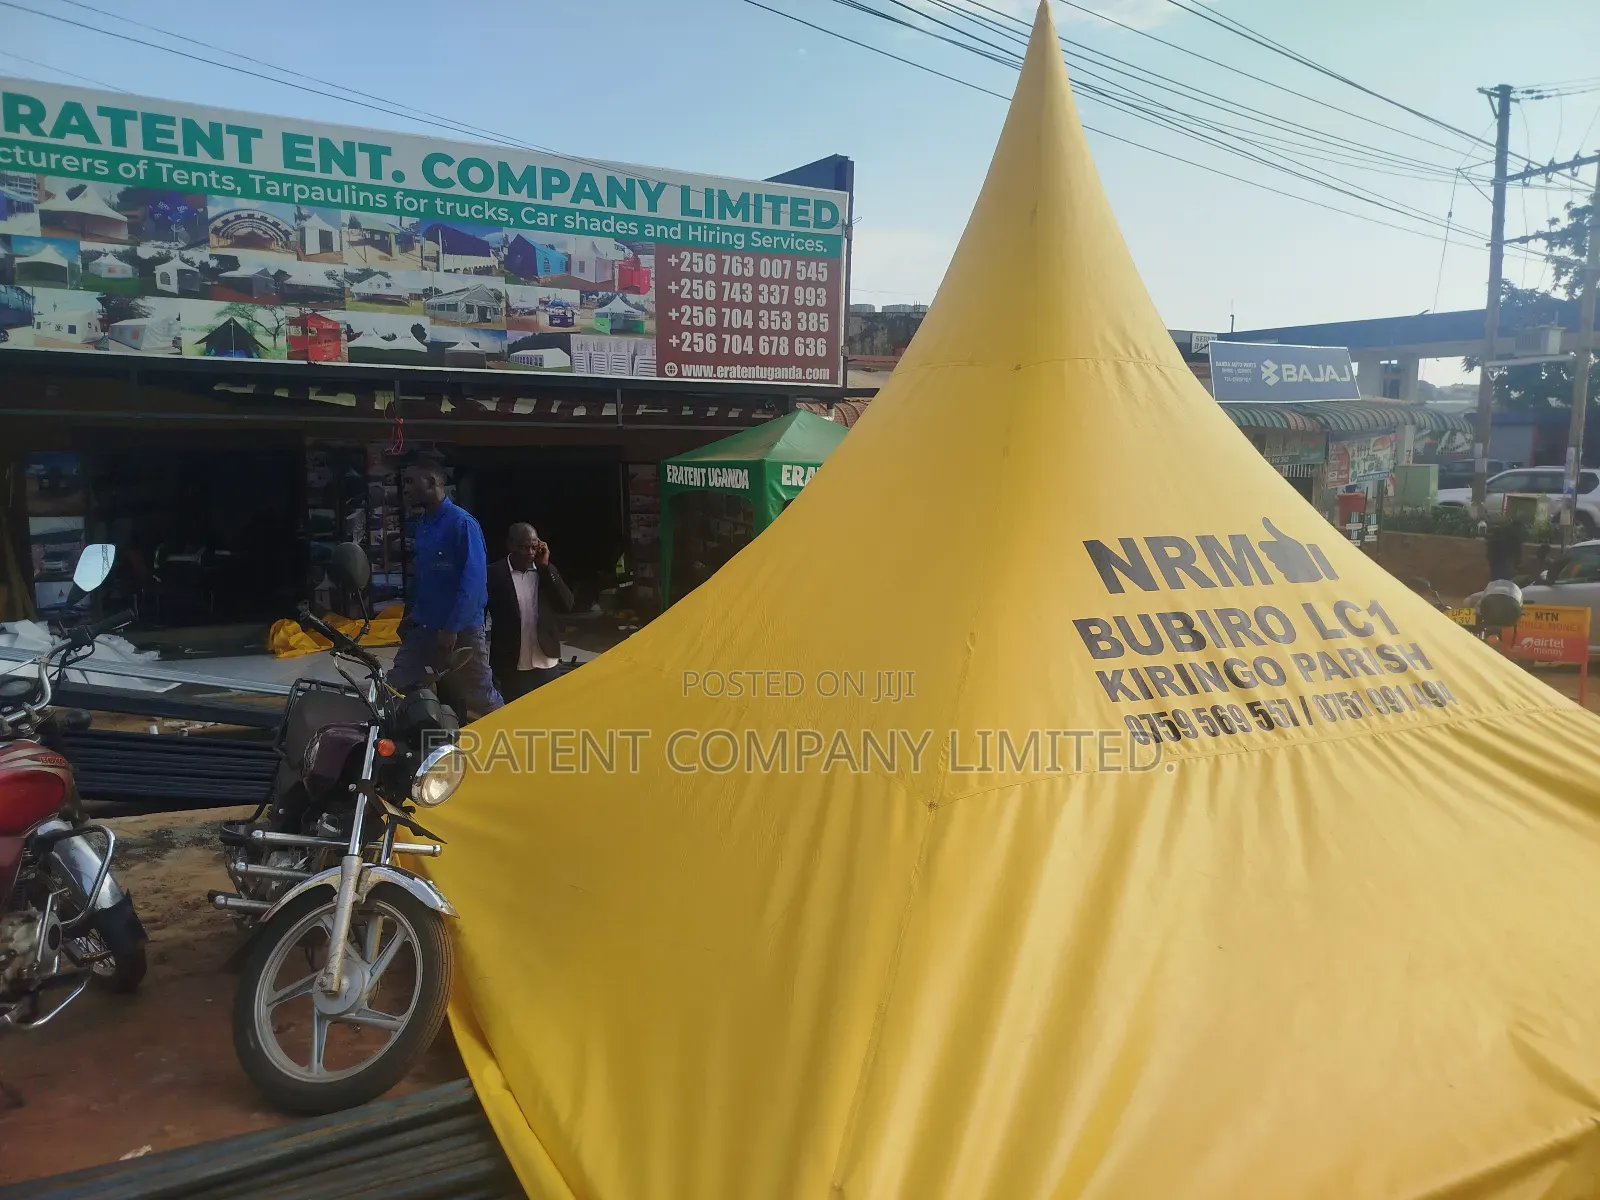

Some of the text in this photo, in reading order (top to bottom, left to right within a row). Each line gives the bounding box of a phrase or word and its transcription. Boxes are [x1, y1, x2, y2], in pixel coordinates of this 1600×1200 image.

[2, 92, 840, 230] RATENT ENT. COMPANY LIMITED
[118, 158, 148, 181] of
[155, 162, 242, 195] Tents,
[250, 173, 389, 210] Tarpaulins
[393, 190, 429, 216] for
[435, 196, 514, 226] trucks,
[521, 207, 558, 227] Car
[564, 211, 639, 236] shades
[644, 220, 682, 241] and
[688, 224, 745, 250] Hiring
[751, 230, 828, 253] Services.
[668, 249, 828, 282] +256 763 007 545
[668, 276, 827, 307] +256 743 337 993
[668, 304, 829, 332] +256 704 353 385
[668, 332, 827, 356] +256 704 678 636
[681, 363, 830, 381] www.eratentuganda.com
[1281, 363, 1351, 382] BAJAJ
[666, 464, 750, 489] ERATENT UGANDA
[782, 464, 823, 487] ERA
[1082, 533, 1275, 595] NRM
[1071, 598, 1401, 660] BUBIRO LC1
[1534, 611, 1559, 621] MTN
[1533, 638, 1564, 649] airtel
[1533, 647, 1563, 657] money
[1094, 641, 1435, 704] KIRINGO PARISH
[1123, 708, 1199, 746] 0759
[1198, 703, 1251, 738] 569
[1245, 697, 1300, 732] 557
[1298, 695, 1313, 726] /
[1313, 691, 1373, 723] 0751
[1367, 685, 1418, 715] 991
